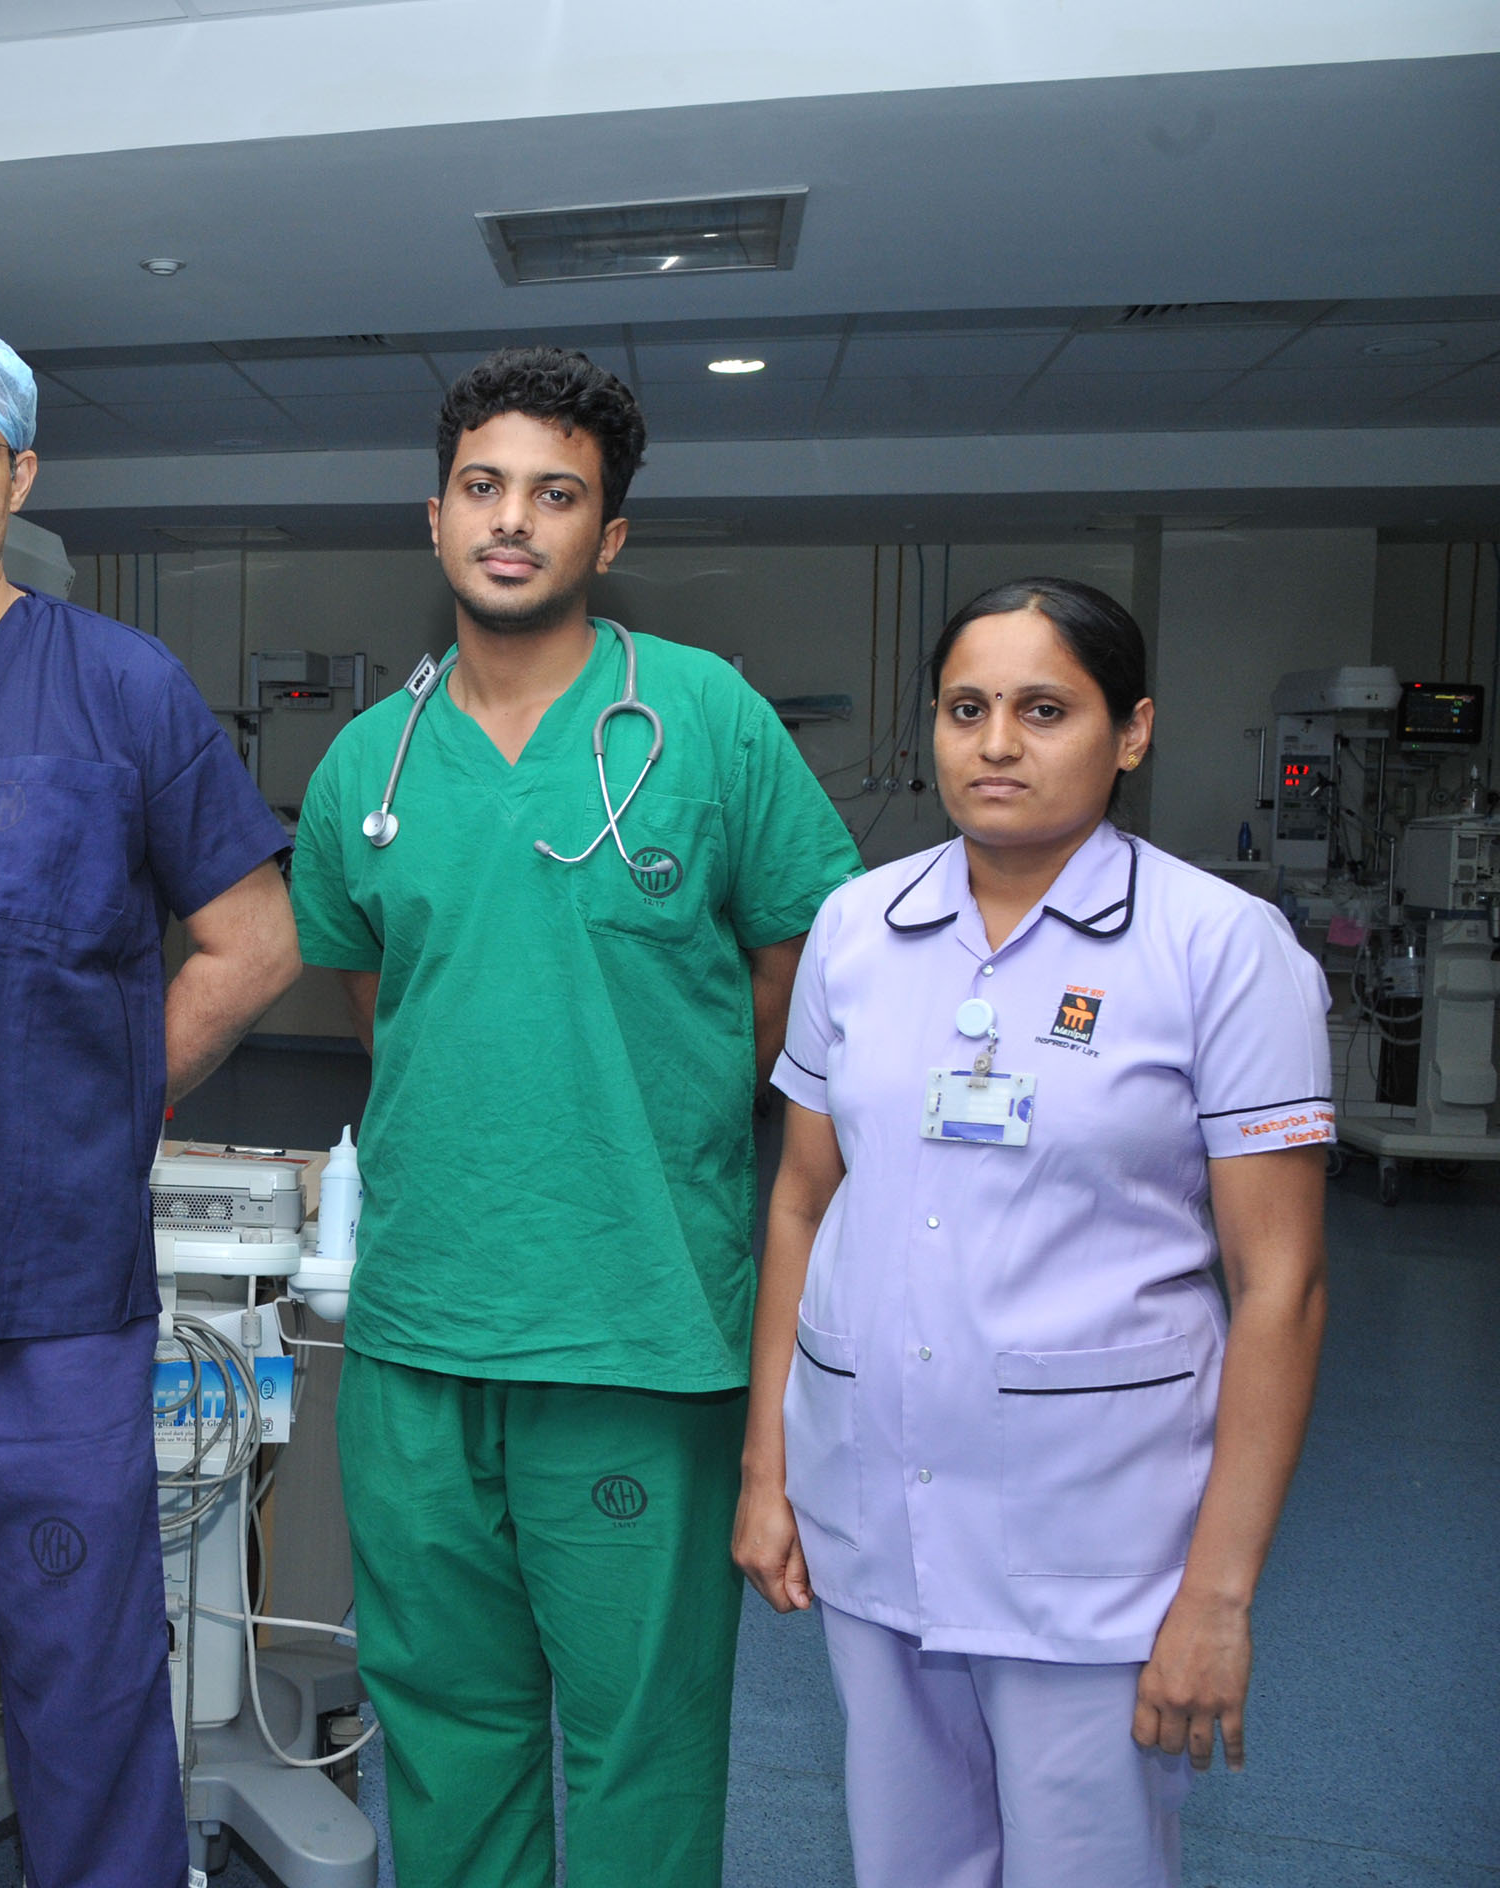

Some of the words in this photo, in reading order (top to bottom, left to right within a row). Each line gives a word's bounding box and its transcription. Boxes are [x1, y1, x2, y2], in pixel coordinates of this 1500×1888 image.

[1053, 1025, 1091, 1043] Manipal
[1241, 1115, 1308, 1138] Kasturba
[602, 1480, 636, 1515] KH
[41, 1526, 71, 1569] KH
